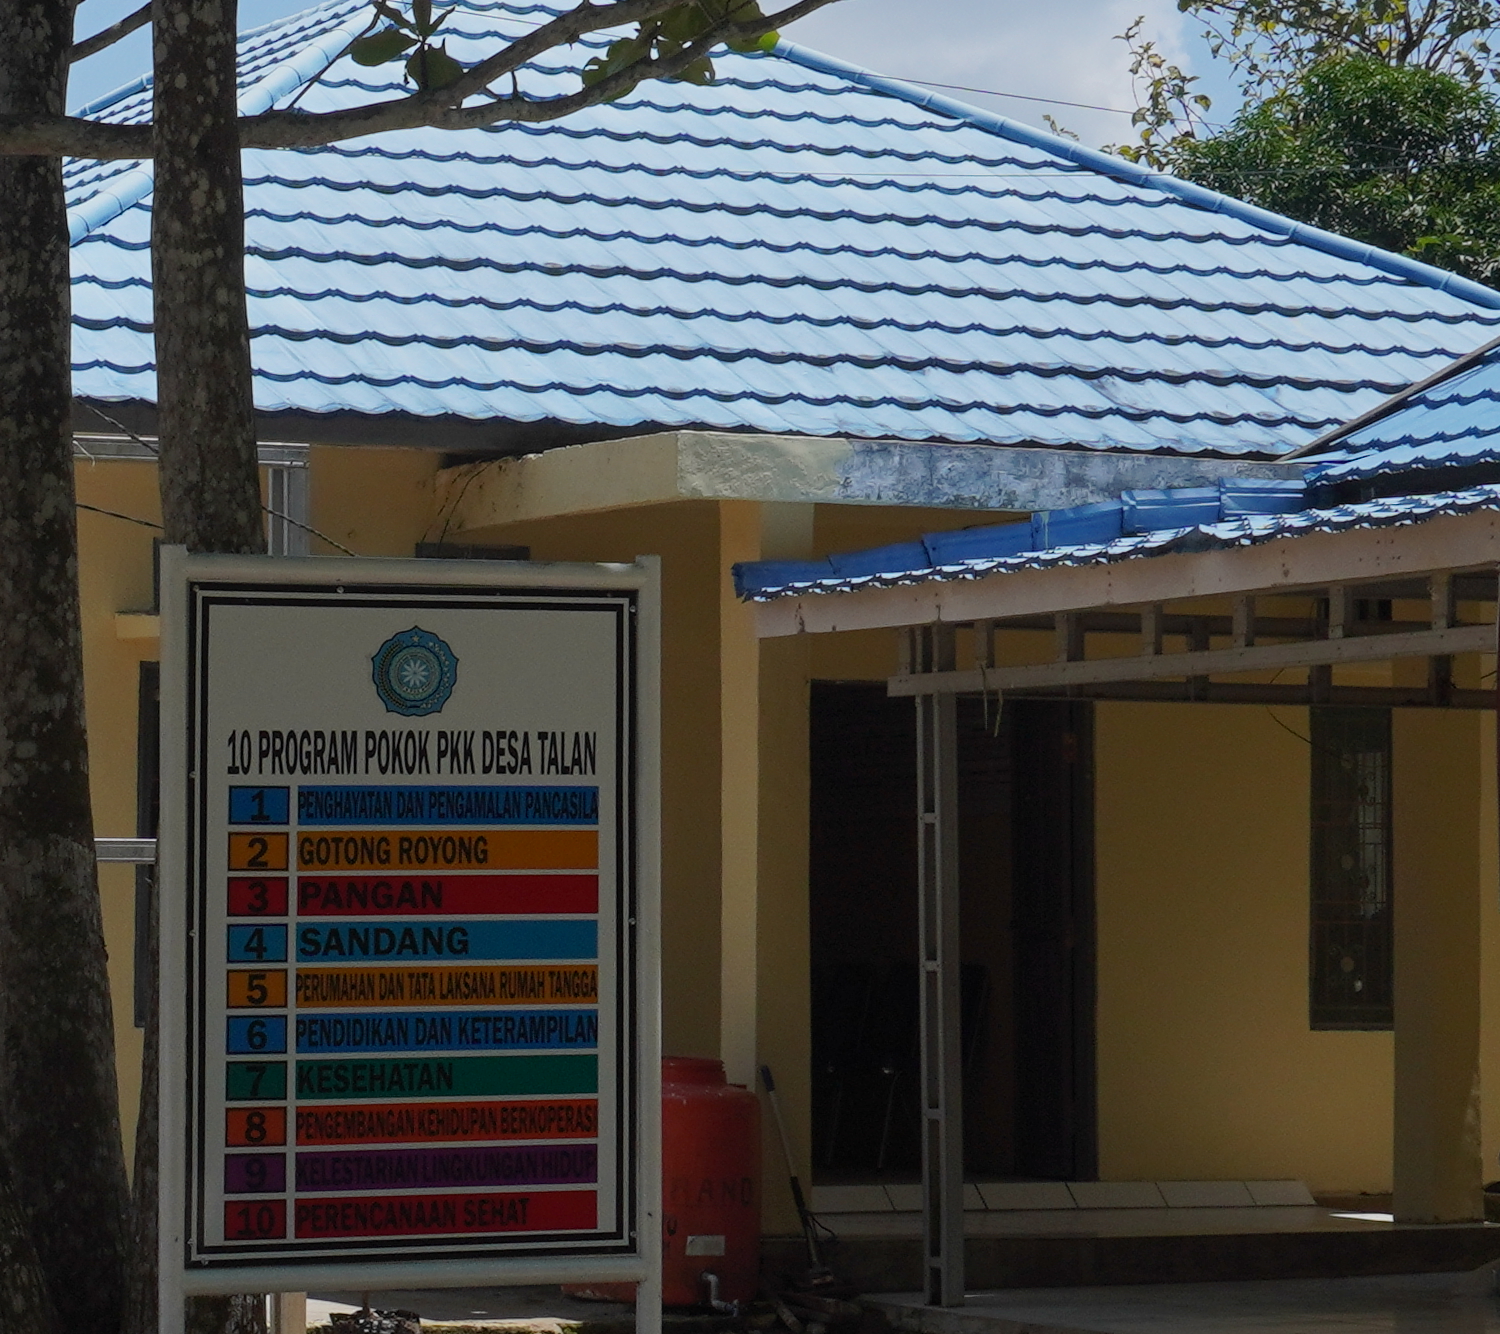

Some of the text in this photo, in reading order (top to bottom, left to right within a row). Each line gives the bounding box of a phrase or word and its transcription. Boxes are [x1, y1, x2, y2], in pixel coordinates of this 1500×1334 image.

[227, 729, 597, 776] 10 PROGRAM POKOK PKK DESA TALAN
[248, 790, 598, 821] 1 PENGHAYATAN DAN PENGAMALAN PANCASILA
[247, 837, 488, 868] 2 GOTONG ROYONG
[247, 882, 444, 912] 3 PANGAN
[243, 927, 469, 958] 4 SANDANG
[246, 971, 597, 1005] 5 PERUMAHAN DAN TATA LAKSANA RUMAH TANGGA
[247, 1014, 597, 1051] 6 PENDIDIKAN DAN KETERAMPILAN
[247, 1063, 453, 1098] 7 KESEHATAN
[245, 1112, 268, 1142] 8
[296, 1111, 414, 1139] PENGEMBANGAN
[418, 1108, 497, 1136] KEHIDUPAN
[246, 1158, 268, 1188] 9
[237, 1198, 530, 1238] 10 PERENCANAAN SEHAT
